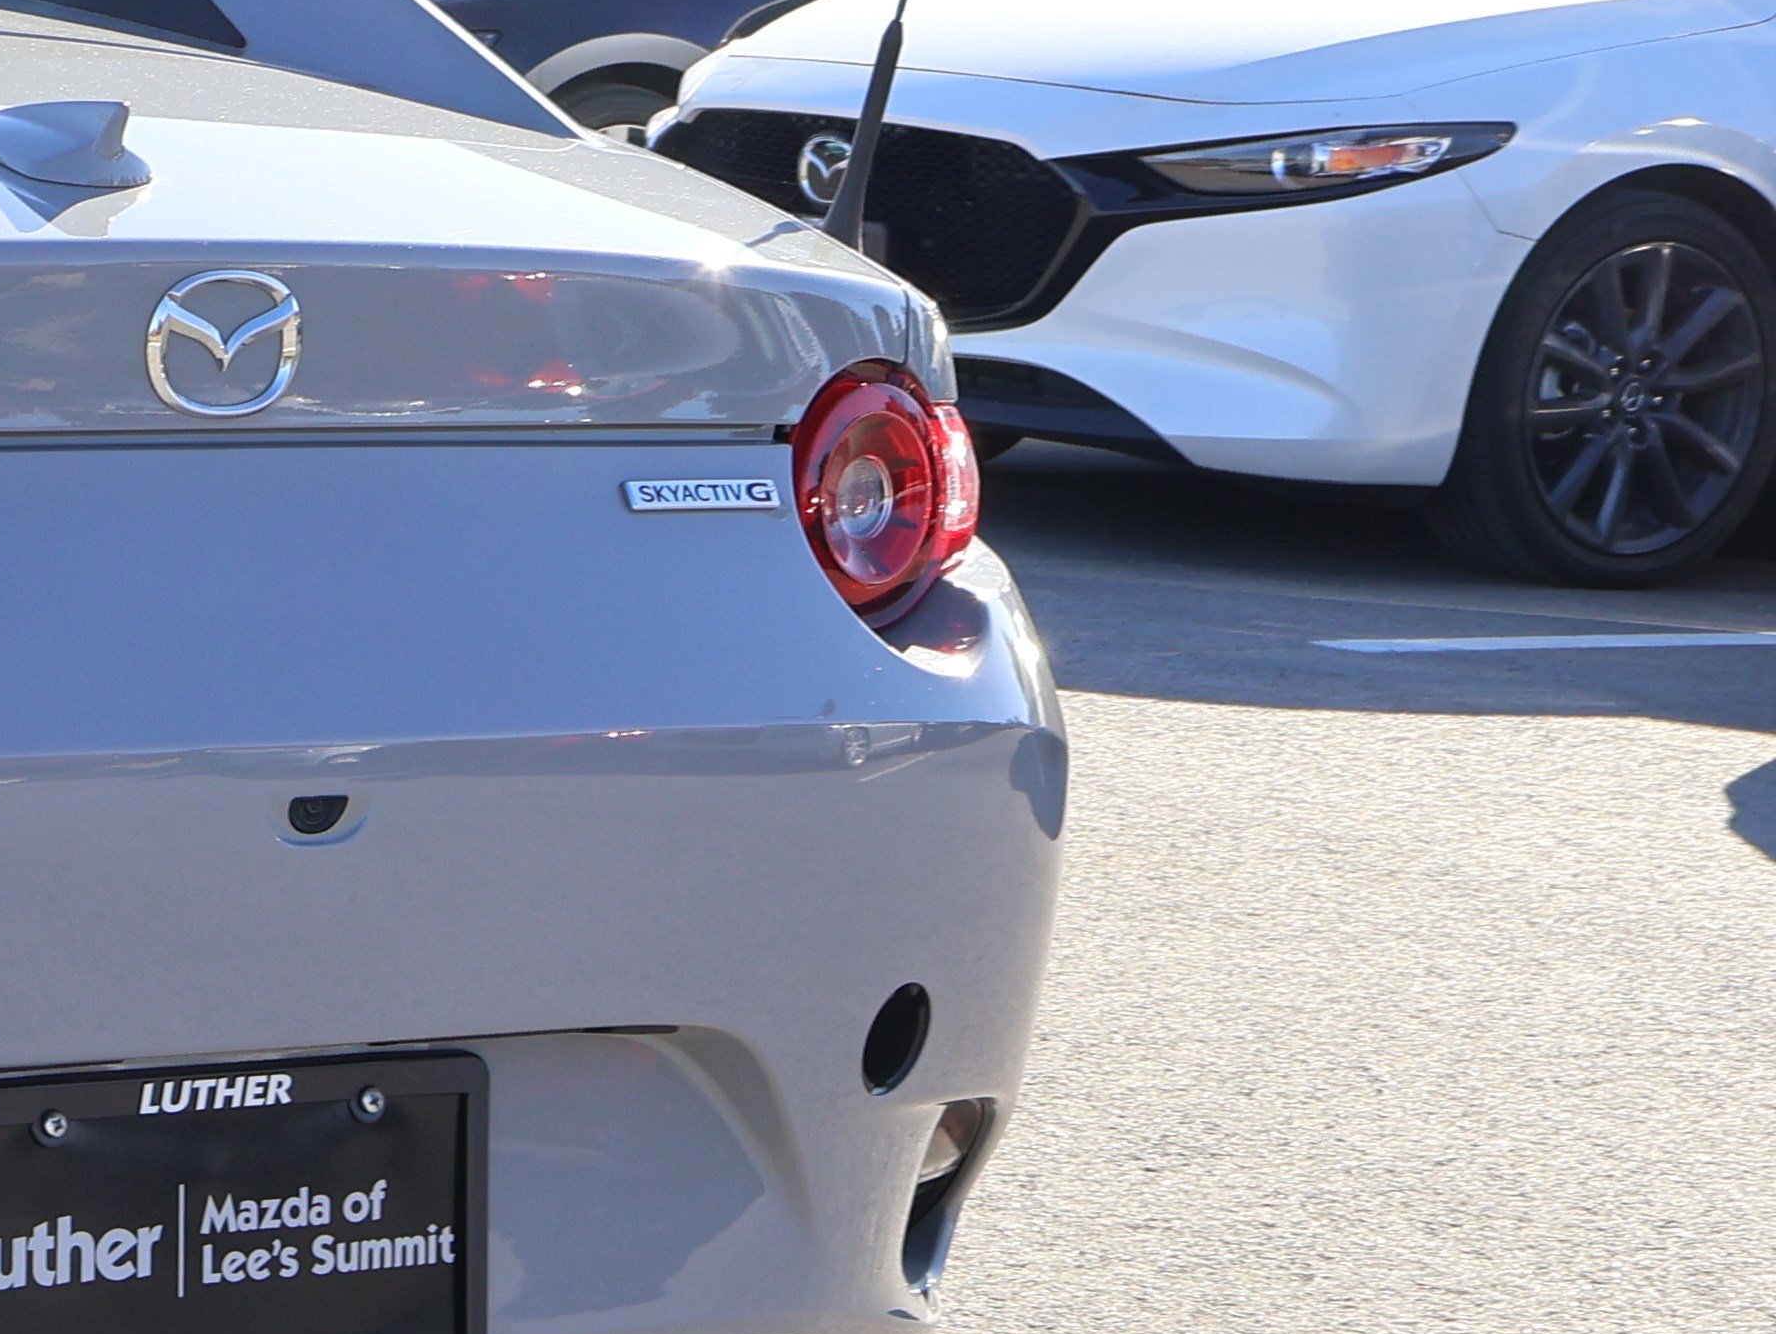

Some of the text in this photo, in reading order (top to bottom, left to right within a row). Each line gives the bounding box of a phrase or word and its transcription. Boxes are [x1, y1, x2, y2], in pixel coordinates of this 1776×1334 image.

[138, 1073, 292, 1115] LUTHER
[199, 1178, 388, 1236] Mazda of
[201, 1223, 457, 1286] Lee's Summit
